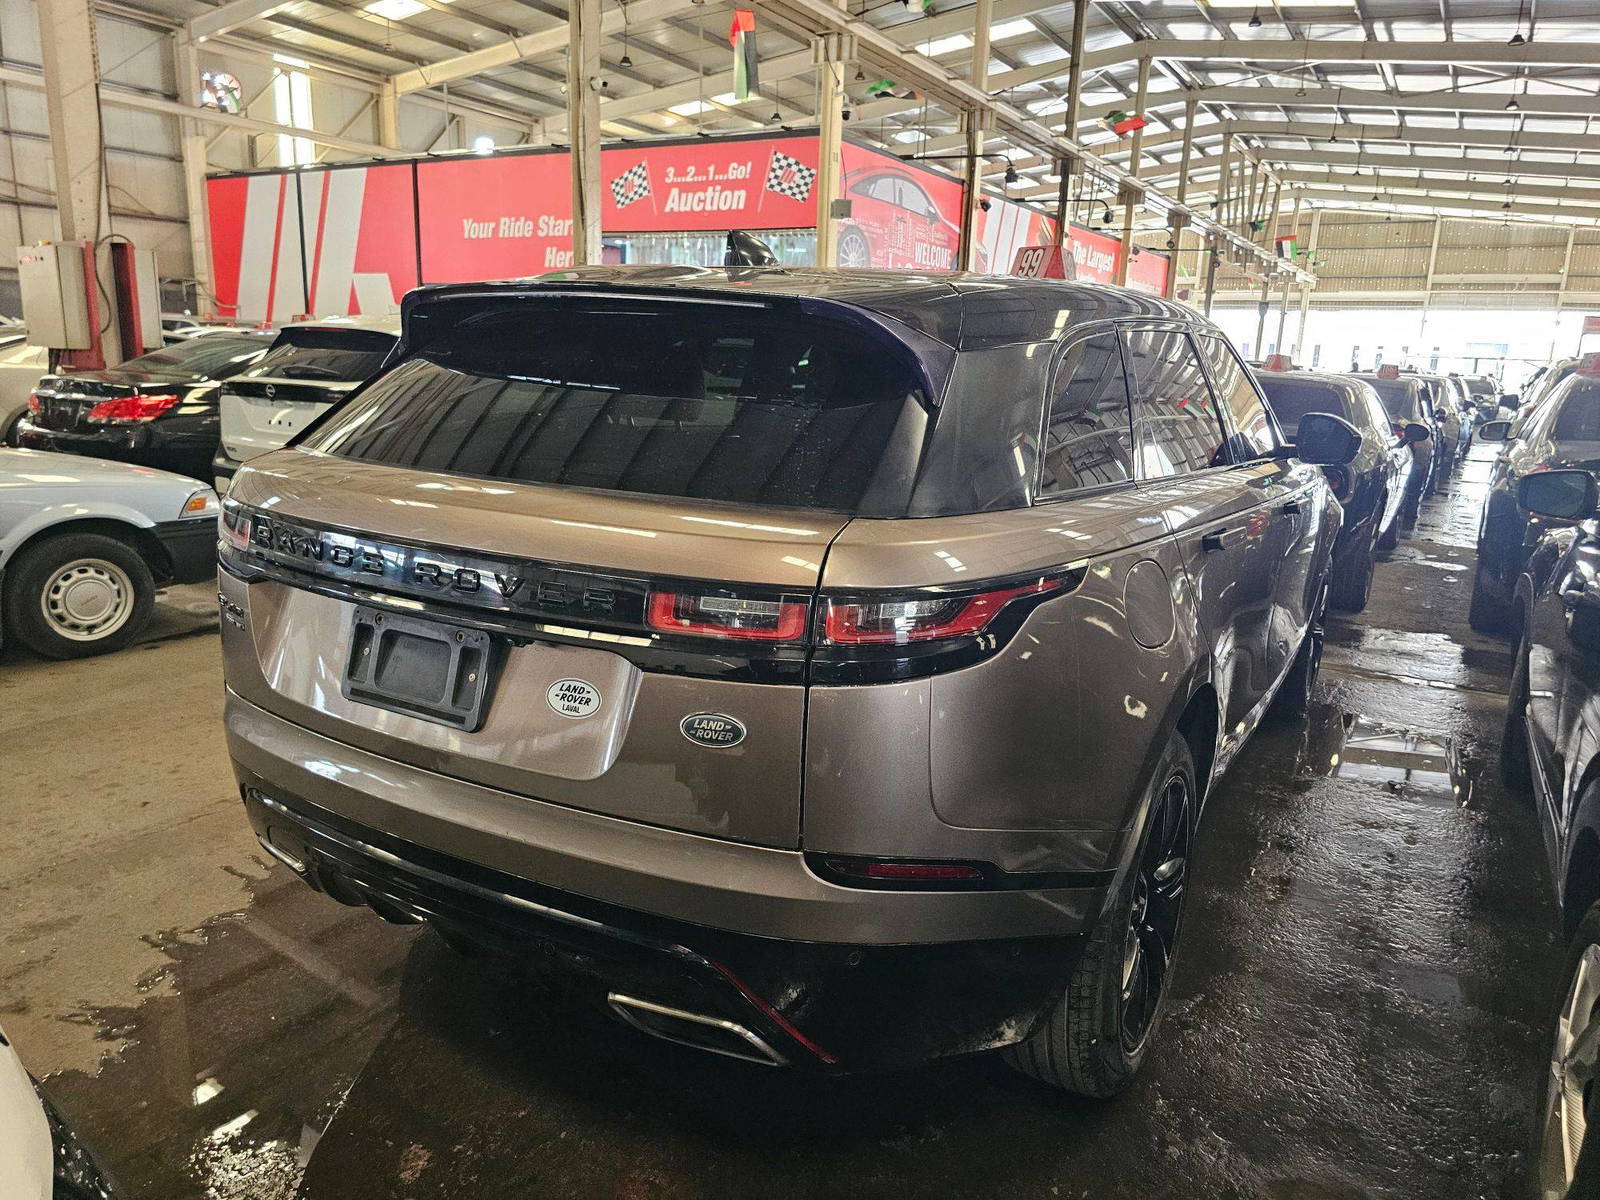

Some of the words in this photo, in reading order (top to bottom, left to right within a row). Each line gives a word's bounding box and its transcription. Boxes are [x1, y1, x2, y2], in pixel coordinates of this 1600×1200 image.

[664, 186, 747, 213] Auction
[463, 218, 496, 239] Your
[499, 217, 534, 238] Ride
[537, 215, 573, 237] Star
[544, 246, 574, 268] Her
[914, 241, 952, 270] WELCOME
[1018, 248, 1045, 278] 99
[1072, 239, 1086, 265] The
[1087, 244, 1115, 274] Largest
[257, 524, 385, 577] RANGE
[415, 561, 616, 615] ROVER
[562, 703, 581, 714] LAVAL
